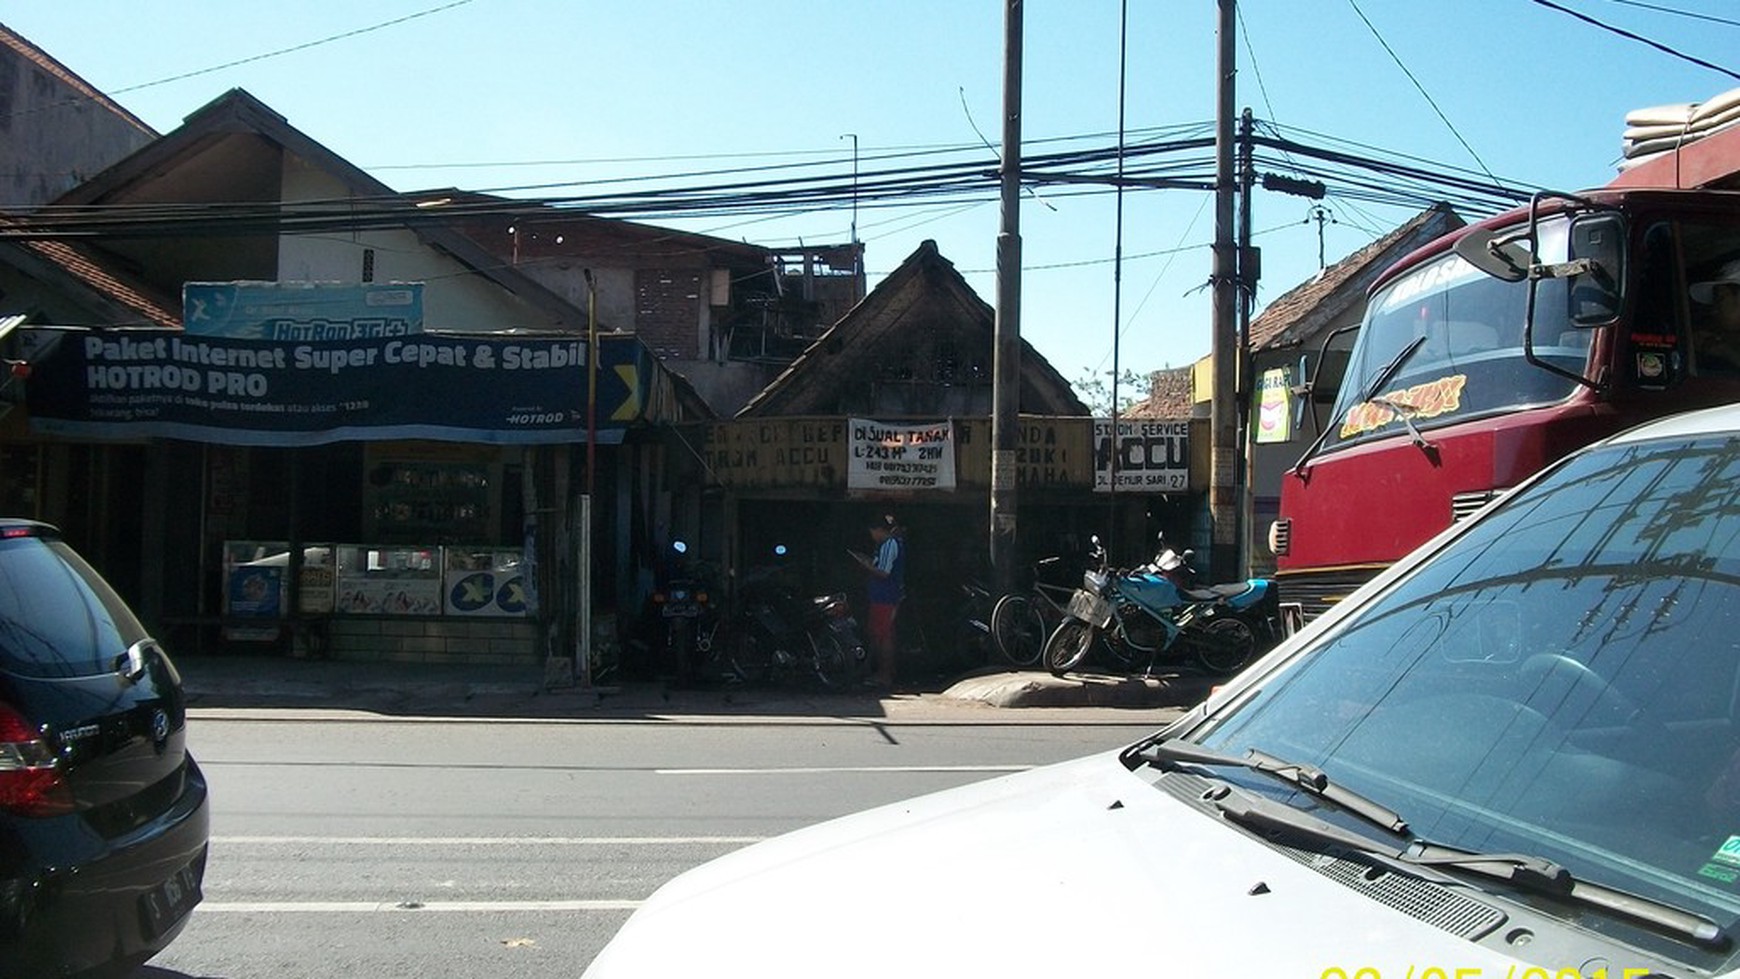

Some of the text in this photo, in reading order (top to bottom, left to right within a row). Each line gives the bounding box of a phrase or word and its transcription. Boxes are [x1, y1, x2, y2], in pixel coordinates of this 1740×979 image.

[84, 336, 586, 374] Paket Internet Super Cepat & Stabil
[86, 364, 269, 397] HOTROD PRO
[506, 412, 564, 425] HOTROD
[1141, 424, 1187, 436] SERVICE
[1097, 437, 1188, 472] ACCU
